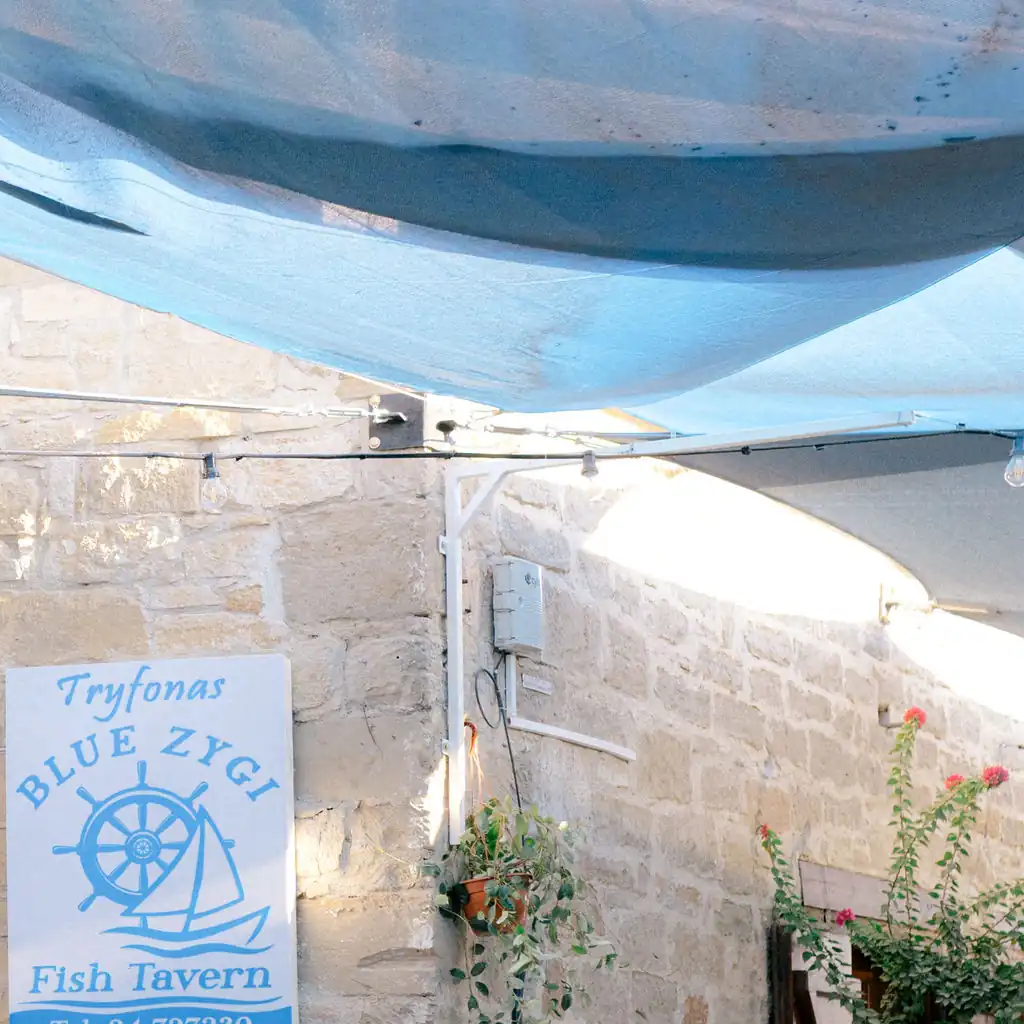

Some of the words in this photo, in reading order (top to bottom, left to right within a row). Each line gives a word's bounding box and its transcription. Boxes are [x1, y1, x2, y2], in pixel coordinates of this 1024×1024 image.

[57, 665, 225, 722] Tryfonas
[17, 726, 136, 808] BLUE
[160, 727, 280, 801] ZYGI
[29, 963, 114, 994] Fish
[128, 963, 273, 993] Tavern
